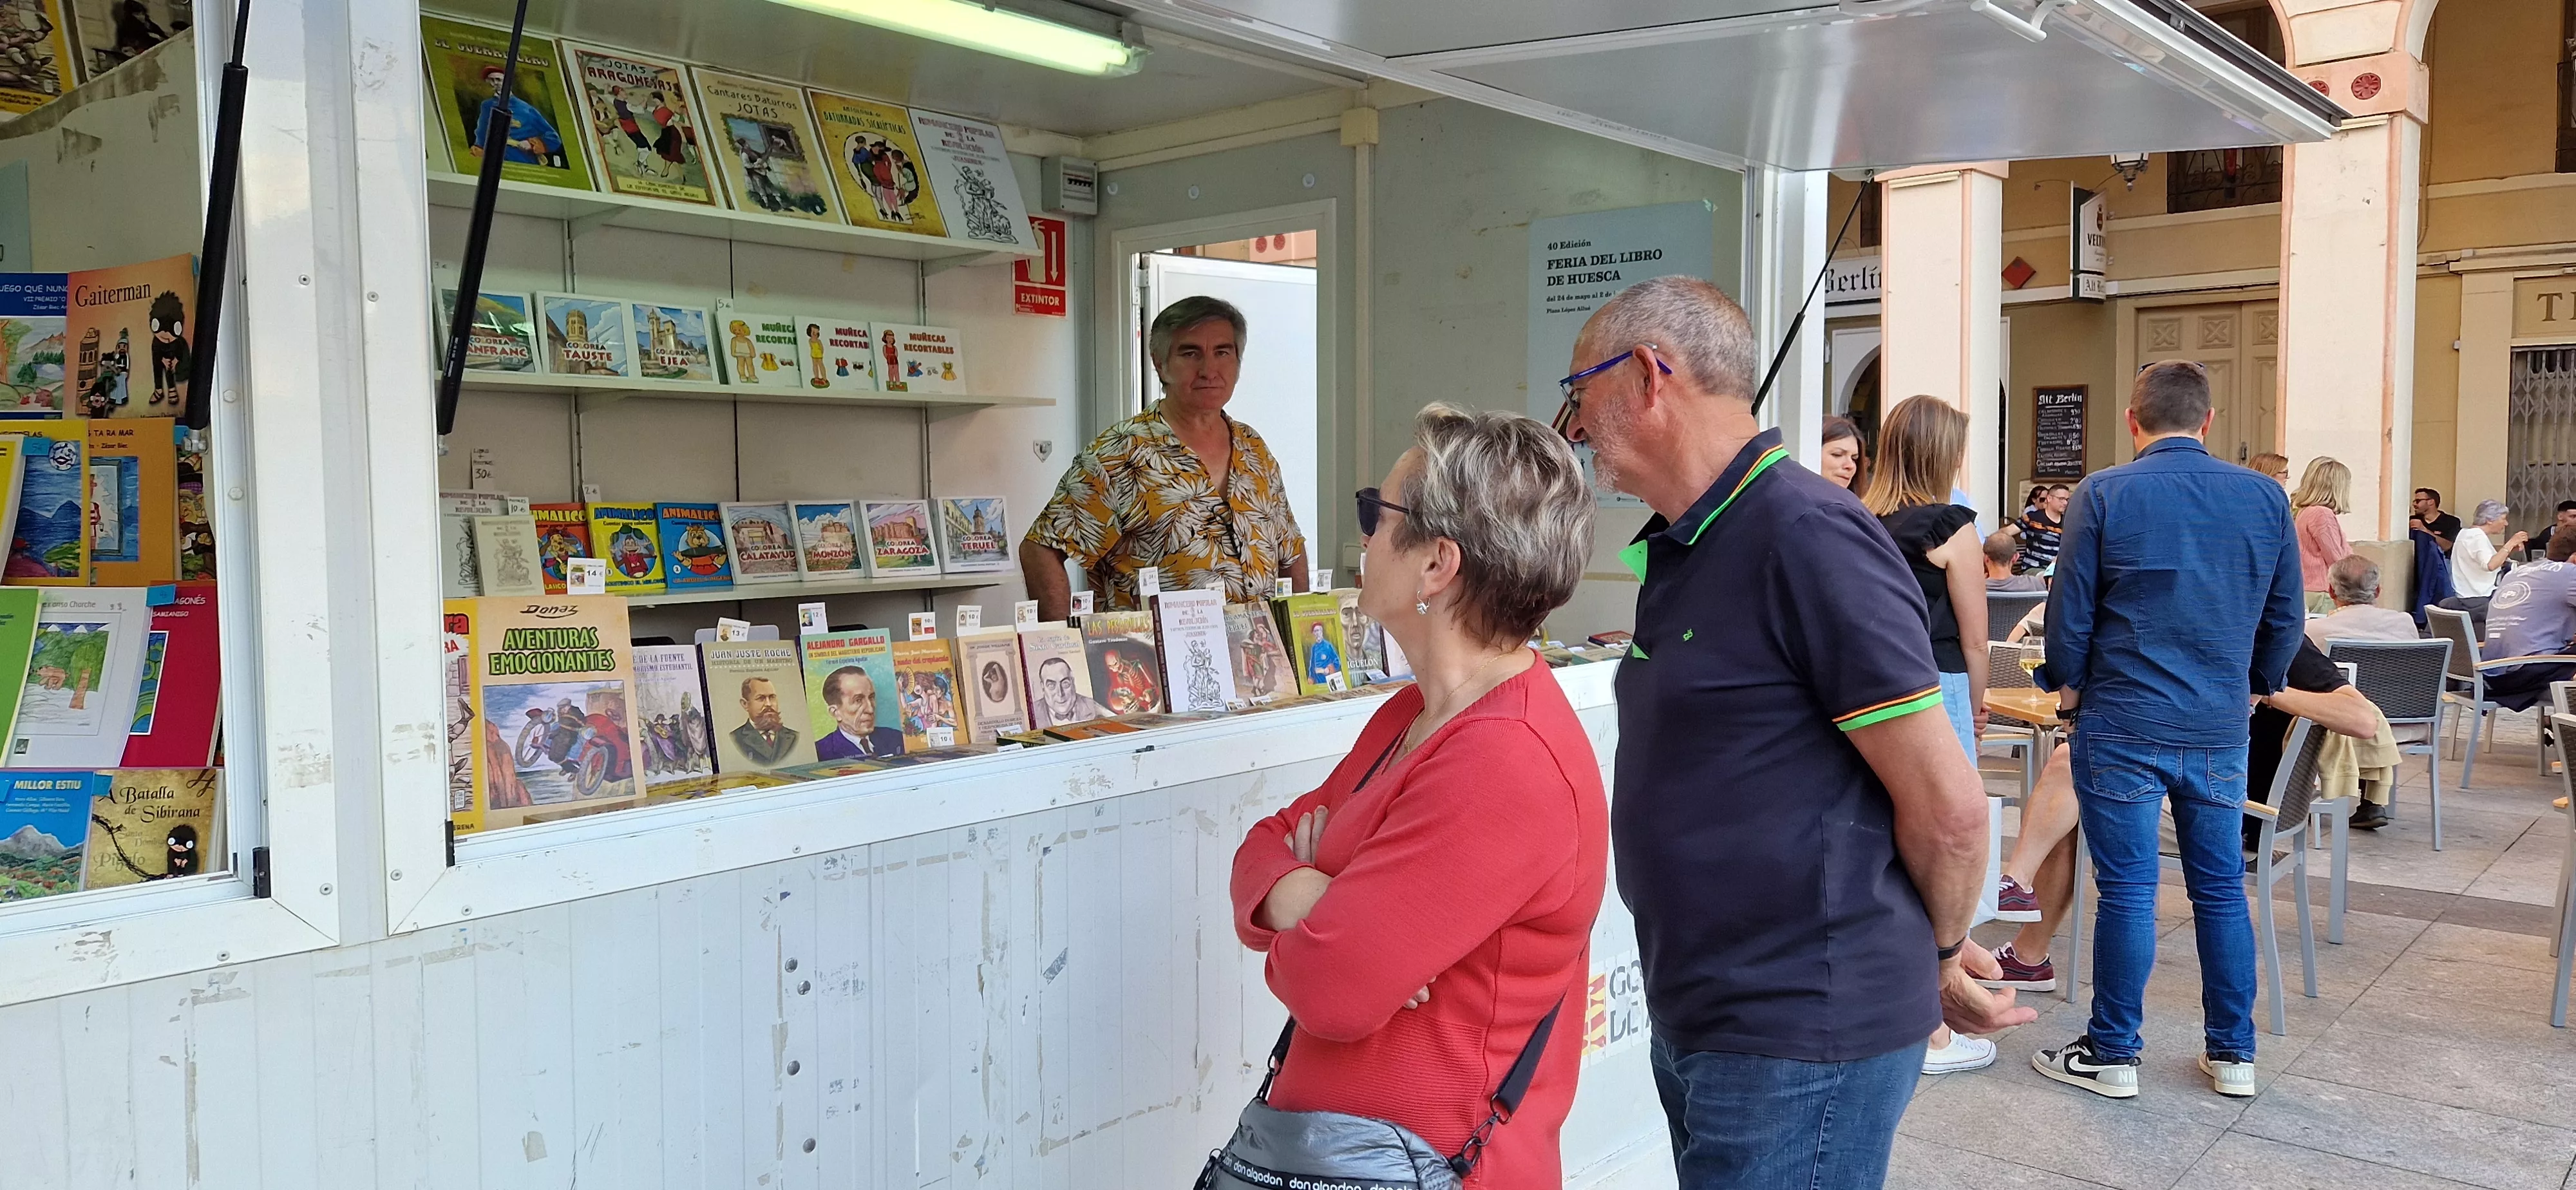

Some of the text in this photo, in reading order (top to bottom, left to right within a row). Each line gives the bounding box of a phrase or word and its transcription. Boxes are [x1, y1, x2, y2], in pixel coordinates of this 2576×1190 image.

[458, 42, 549, 66] GUERRILERO
[607, 60, 646, 74] JOTAS
[706, 86, 752, 102] Cantares
[737, 103, 778, 118] JOTAS
[1548, 239, 1591, 250] 40 Edición
[1547, 249, 1663, 270] FERIA DEL LIBRO
[1547, 270, 1621, 287] DE HUESCA
[24, 285, 43, 293] QUE
[75, 283, 151, 307] Gaiterman
[1021, 293, 1059, 306] EXTINTOR
[909, 332, 946, 343] MUÑECAS
[468, 345, 527, 357] ANFRANC
[904, 343, 954, 354] RECORTABLES
[564, 350, 612, 362] TAUSTE
[660, 356, 688, 366] EJEA
[2038, 393, 2082, 405] Alt Berlin
[813, 548, 851, 558] MONZÓN
[876, 546, 929, 556] ZARAGOZA
[961, 542, 996, 551] TERUEL
[741, 551, 795, 560] CALATAYUD
[173, 594, 206, 605] AGONÉS
[1087, 620, 1103, 636] LAS
[1107, 616, 1151, 634] PESADILLAS
[502, 627, 600, 651] AVENTURAS
[807, 636, 885, 650] ALEJANDRO GARGALLO
[488, 649, 616, 675] EMOCIONANTES
[639, 653, 685, 663] DE LA FUENTE
[1347, 656, 1378, 669] IGUELÓN
[14, 780, 82, 789] MILLOR ESTIU
[120, 786, 174, 804] Batalla
[124, 805, 200, 823] de Sibirana
[2222, 1067, 2249, 1081] NIKE
[1233, 1160, 1283, 1187] don algodon
